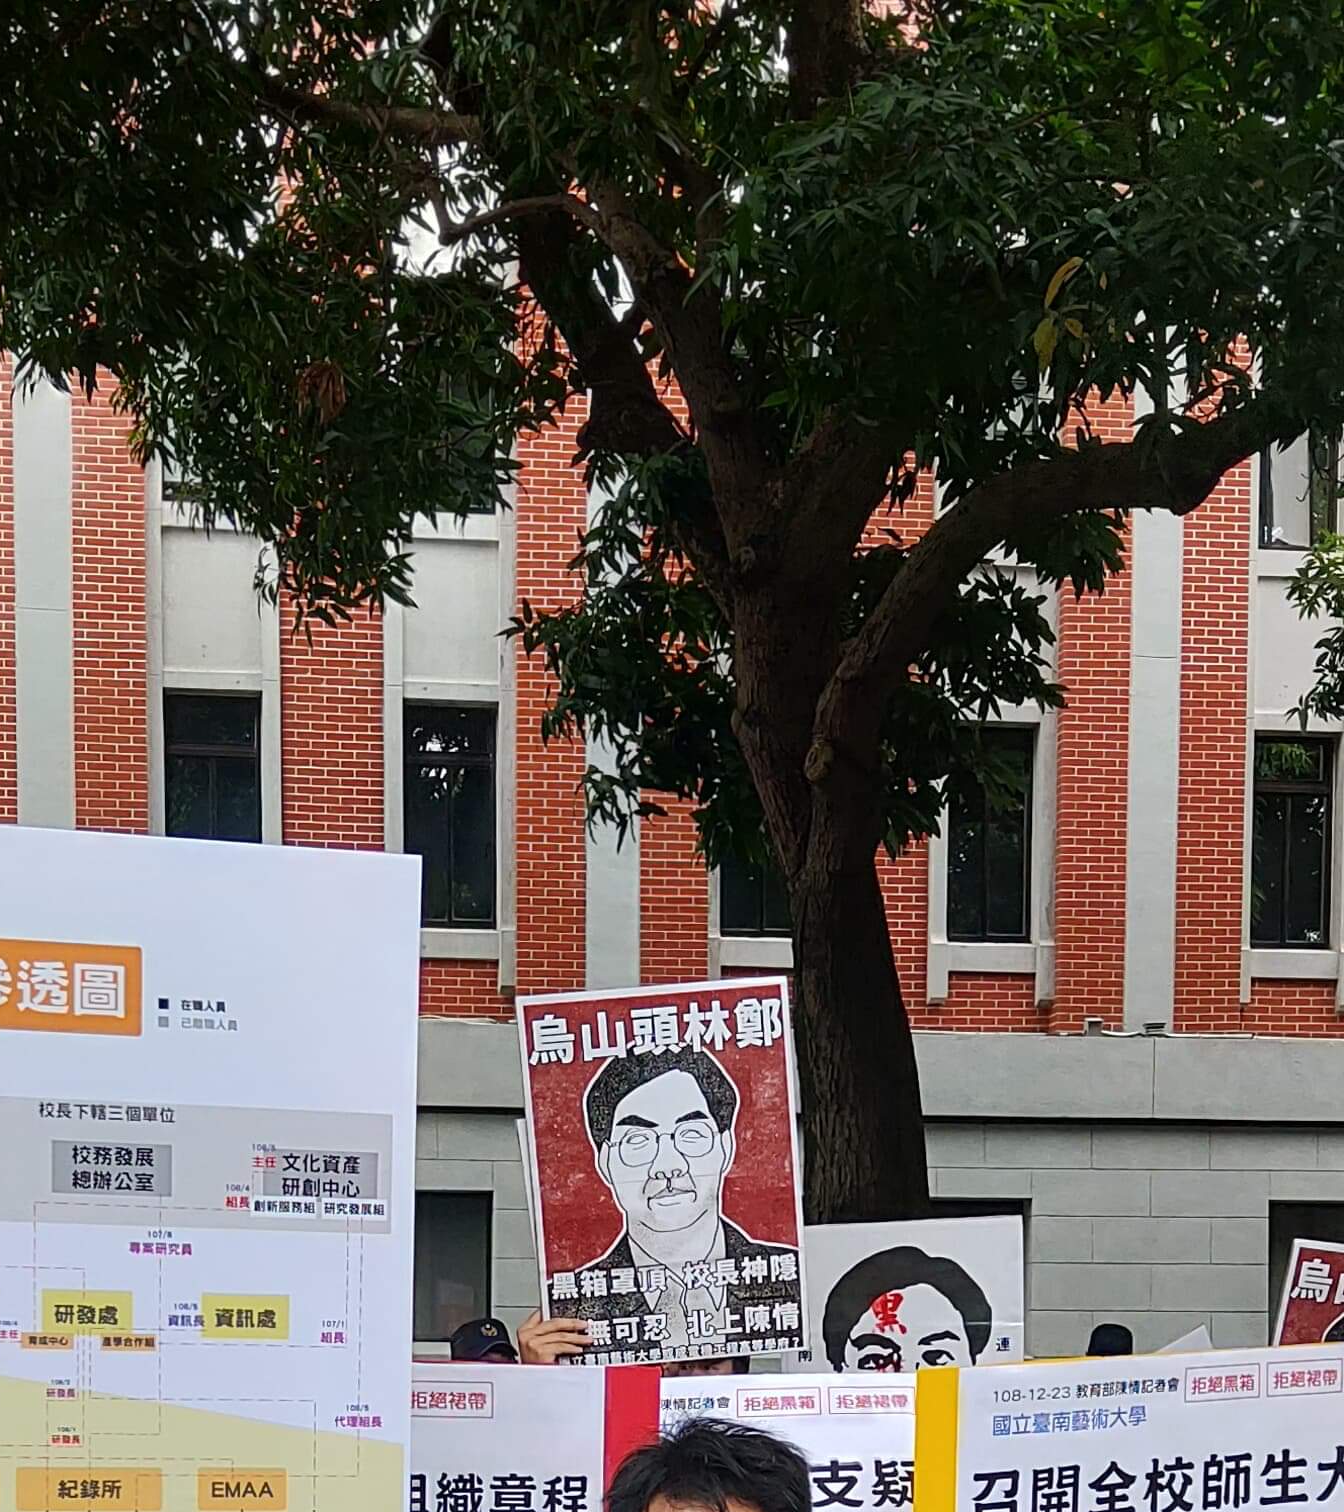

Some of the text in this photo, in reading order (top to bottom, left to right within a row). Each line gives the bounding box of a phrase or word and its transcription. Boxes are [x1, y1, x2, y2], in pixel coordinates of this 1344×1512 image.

[528, 997, 784, 1066] 烏山頭林鄭
[40, 1101, 176, 1123] 校長下轄三個單位
[72, 1145, 154, 1167] 校務發展
[252, 1156, 277, 1168] 主任
[282, 1152, 361, 1175] 文化資產
[72, 1171, 154, 1192] 總辦公室
[281, 1178, 361, 1198] 研創中心
[225, 1197, 250, 1209] 組長
[324, 1201, 385, 1216] 研究發展組
[551, 1253, 799, 1301] 黑箱罩頂 校長神隱
[54, 1304, 119, 1326] 研發處
[215, 1308, 277, 1329] 資訊處
[586, 1304, 801, 1349] 無可忍 北上陳情
[320, 1332, 345, 1344] 組長
[992, 1376, 1180, 1403] 108-12-23 教育部陳情記者會
[1191, 1374, 1255, 1395] 拒絕黑箱
[1272, 1369, 1339, 1390] 拒絕裙帶
[743, 1394, 816, 1411] 拒絕黑箱
[835, 1394, 909, 1410] 拒絕裙帶
[992, 1405, 1148, 1437] 國立臺南藝術大學
[58, 1479, 122, 1500] 紀錄所
[211, 1481, 274, 1499] EMAA
